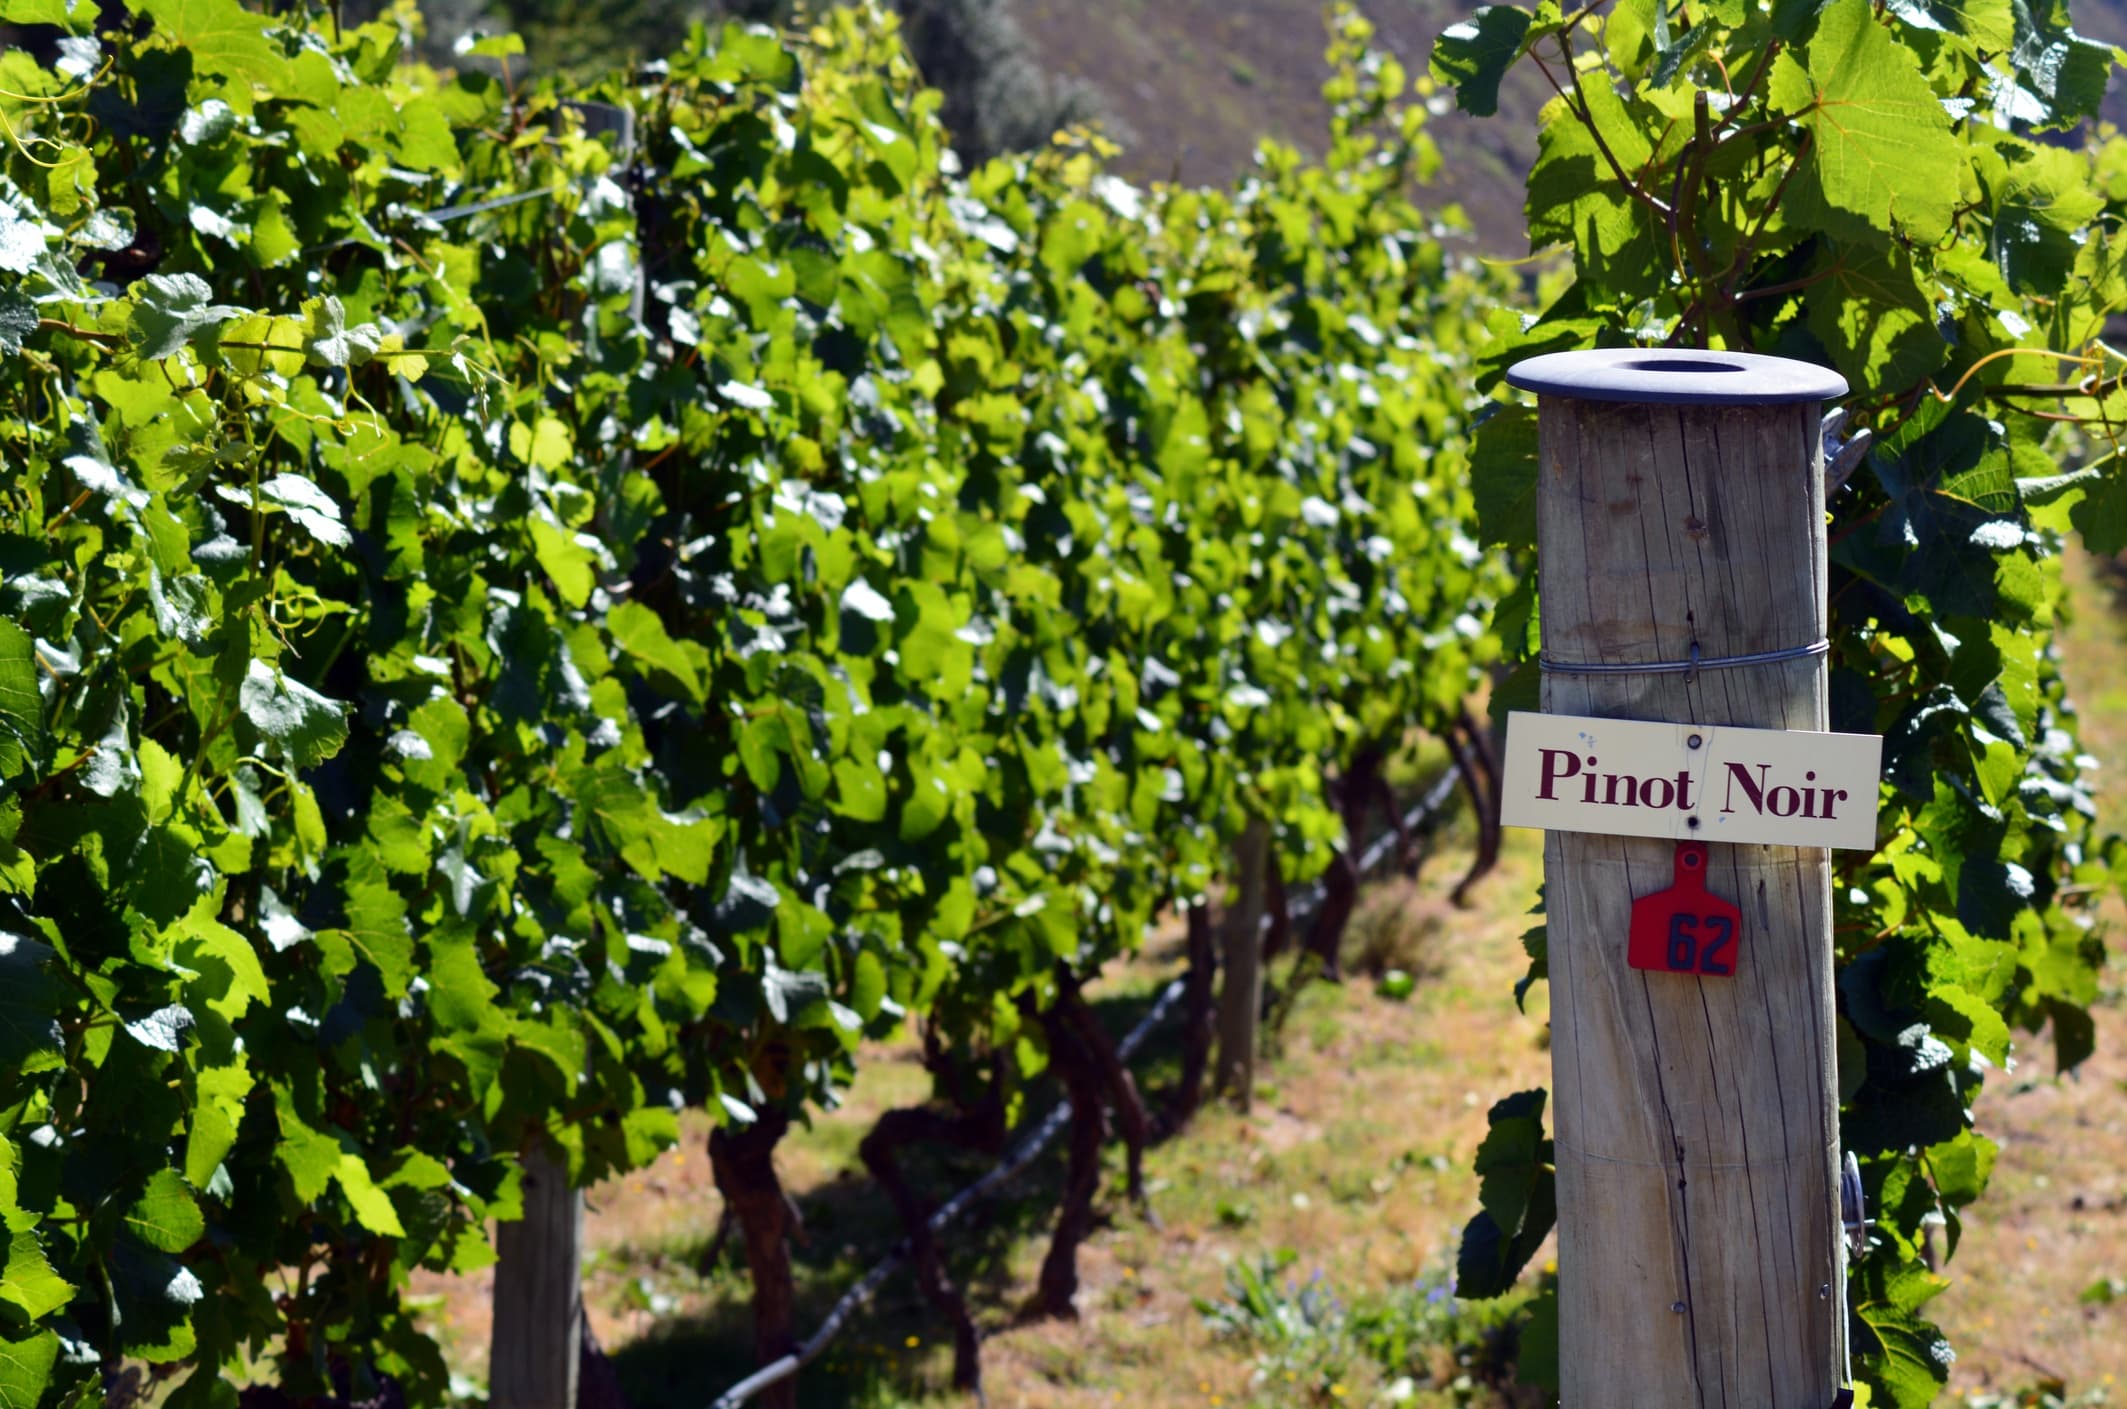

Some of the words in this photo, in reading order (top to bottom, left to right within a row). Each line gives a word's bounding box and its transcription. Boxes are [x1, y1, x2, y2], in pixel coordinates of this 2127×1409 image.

[1535, 748, 1696, 810] Pinot
[1719, 762, 1848, 820] Noir
[1667, 912, 1733, 975] 62
